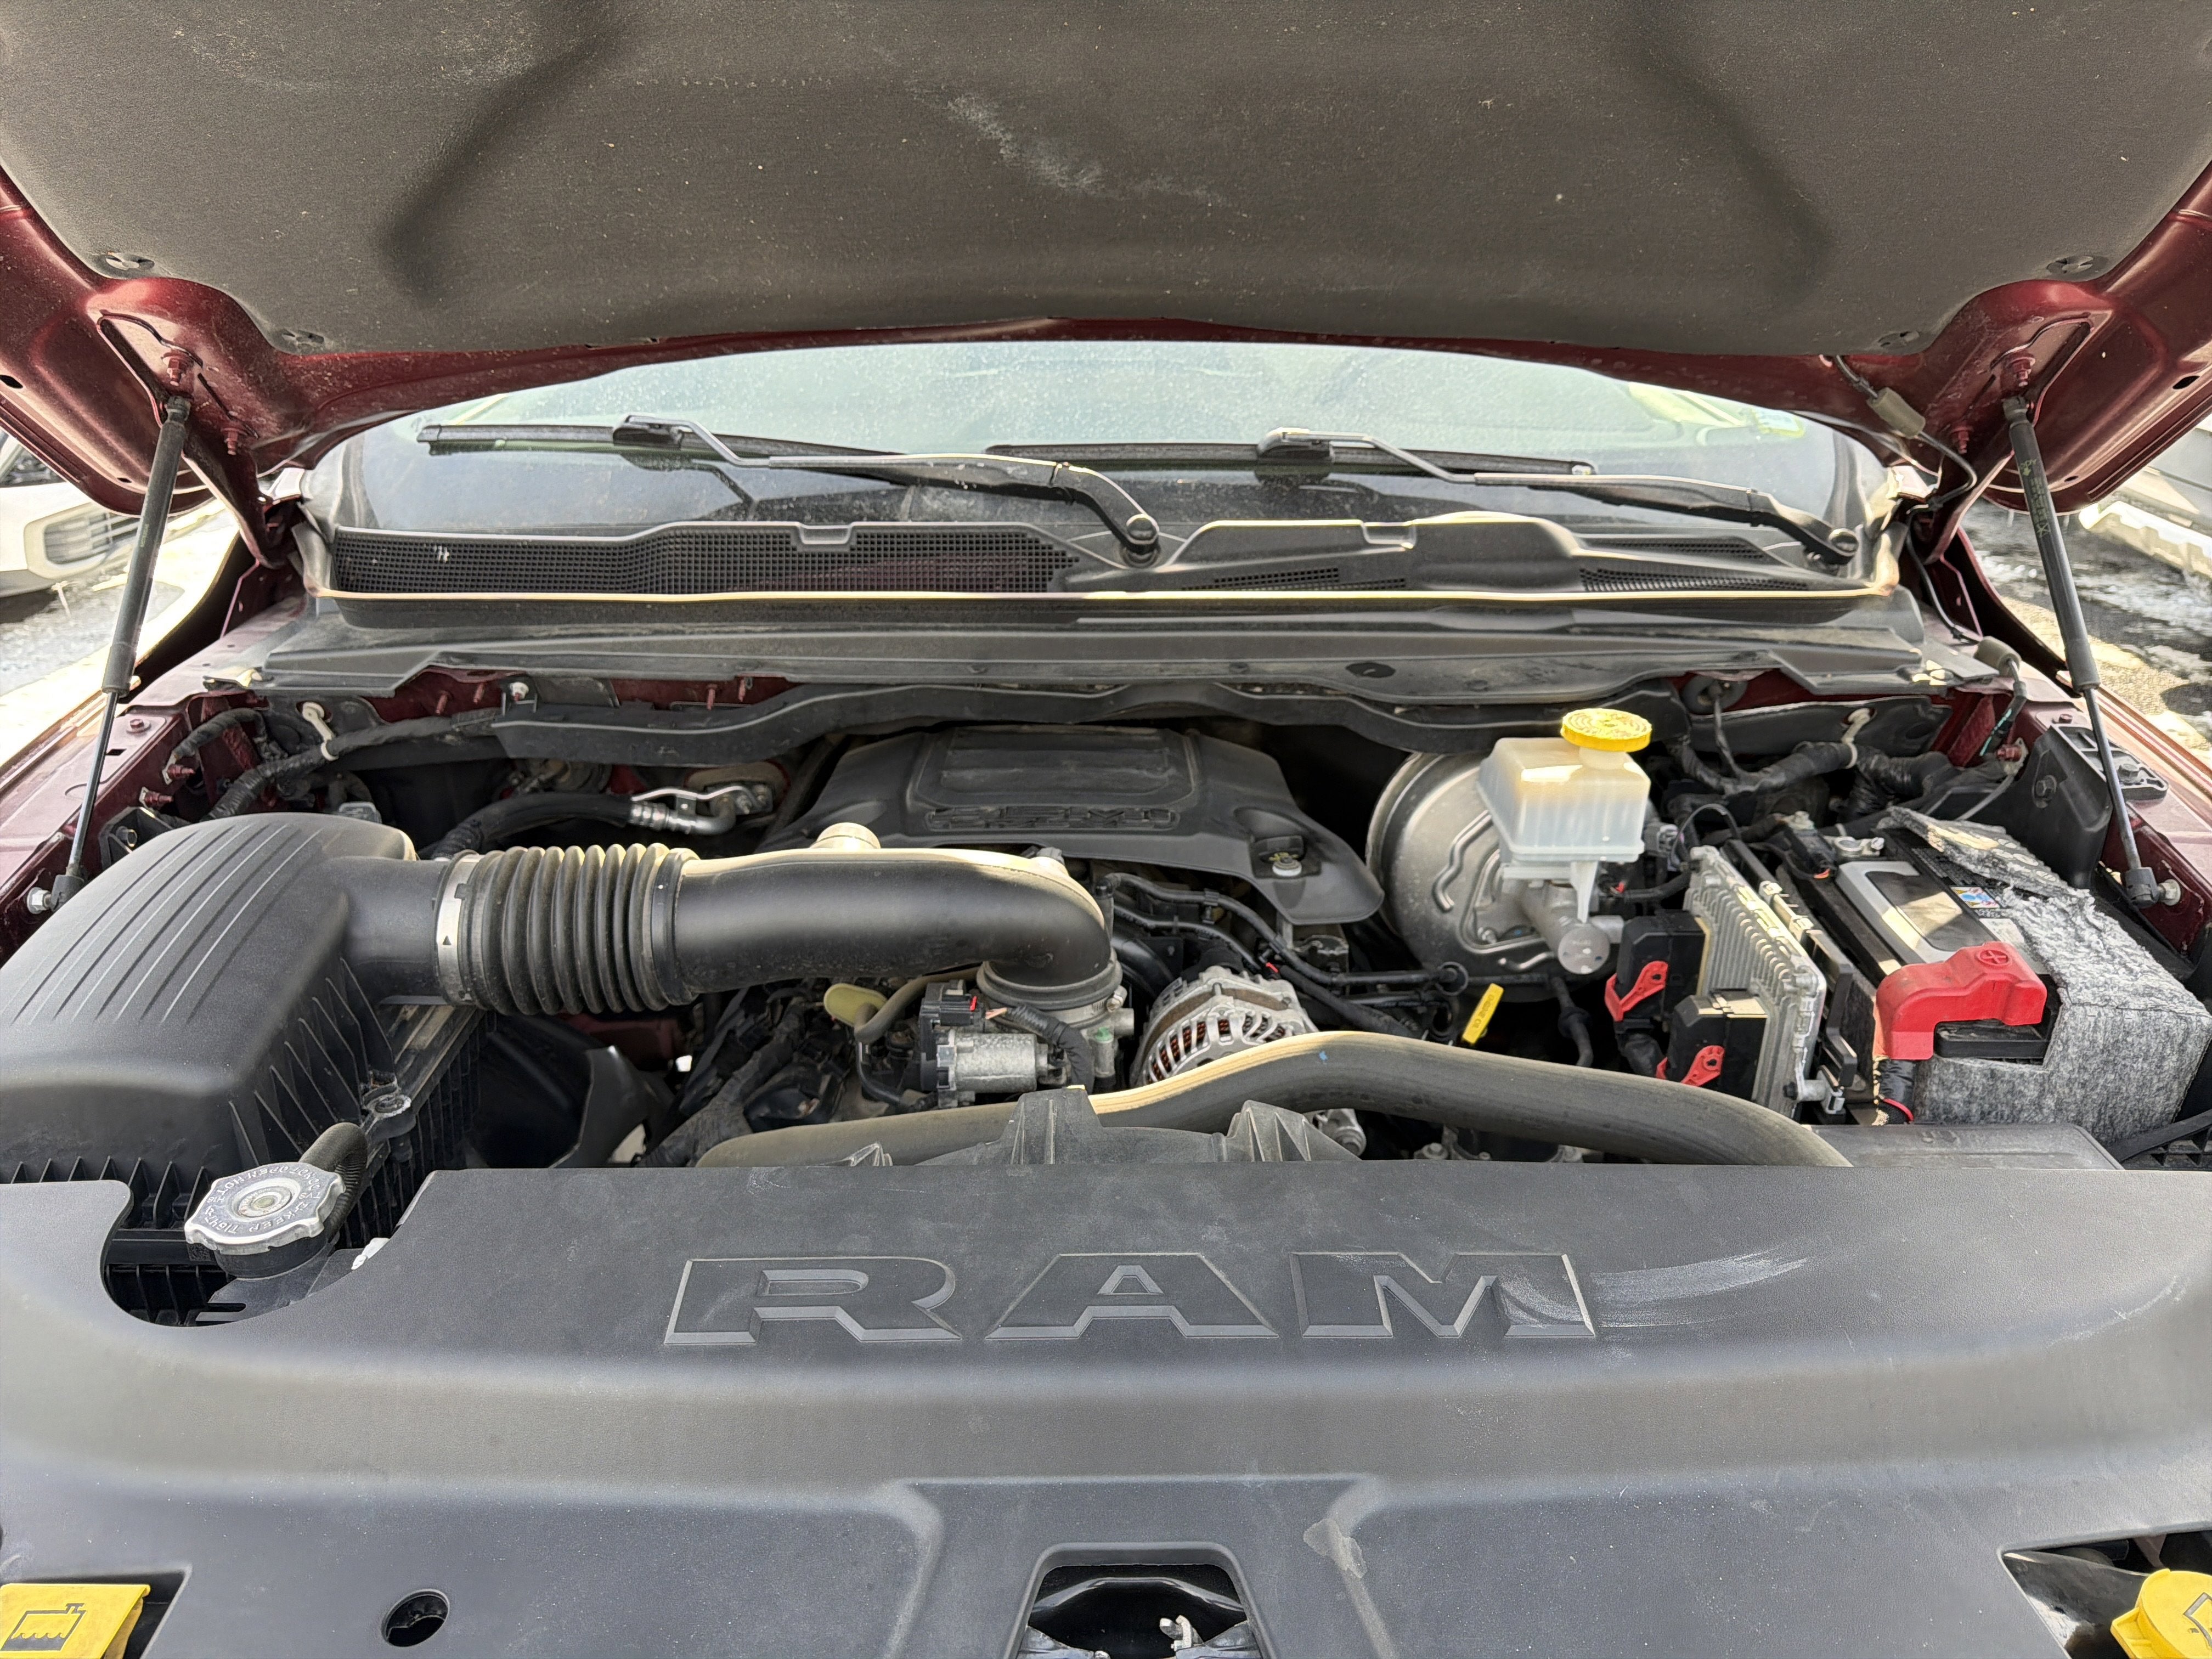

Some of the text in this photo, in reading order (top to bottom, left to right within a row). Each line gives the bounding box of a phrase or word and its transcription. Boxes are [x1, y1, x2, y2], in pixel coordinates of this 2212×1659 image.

[247, 1166, 289, 1178] OPEN
[290, 1167, 315, 1180] NOT
[216, 1176, 245, 1195] HOT
[204, 1211, 295, 1234] KEEP TIGHT
[663, 1251, 1596, 1345] RAM
